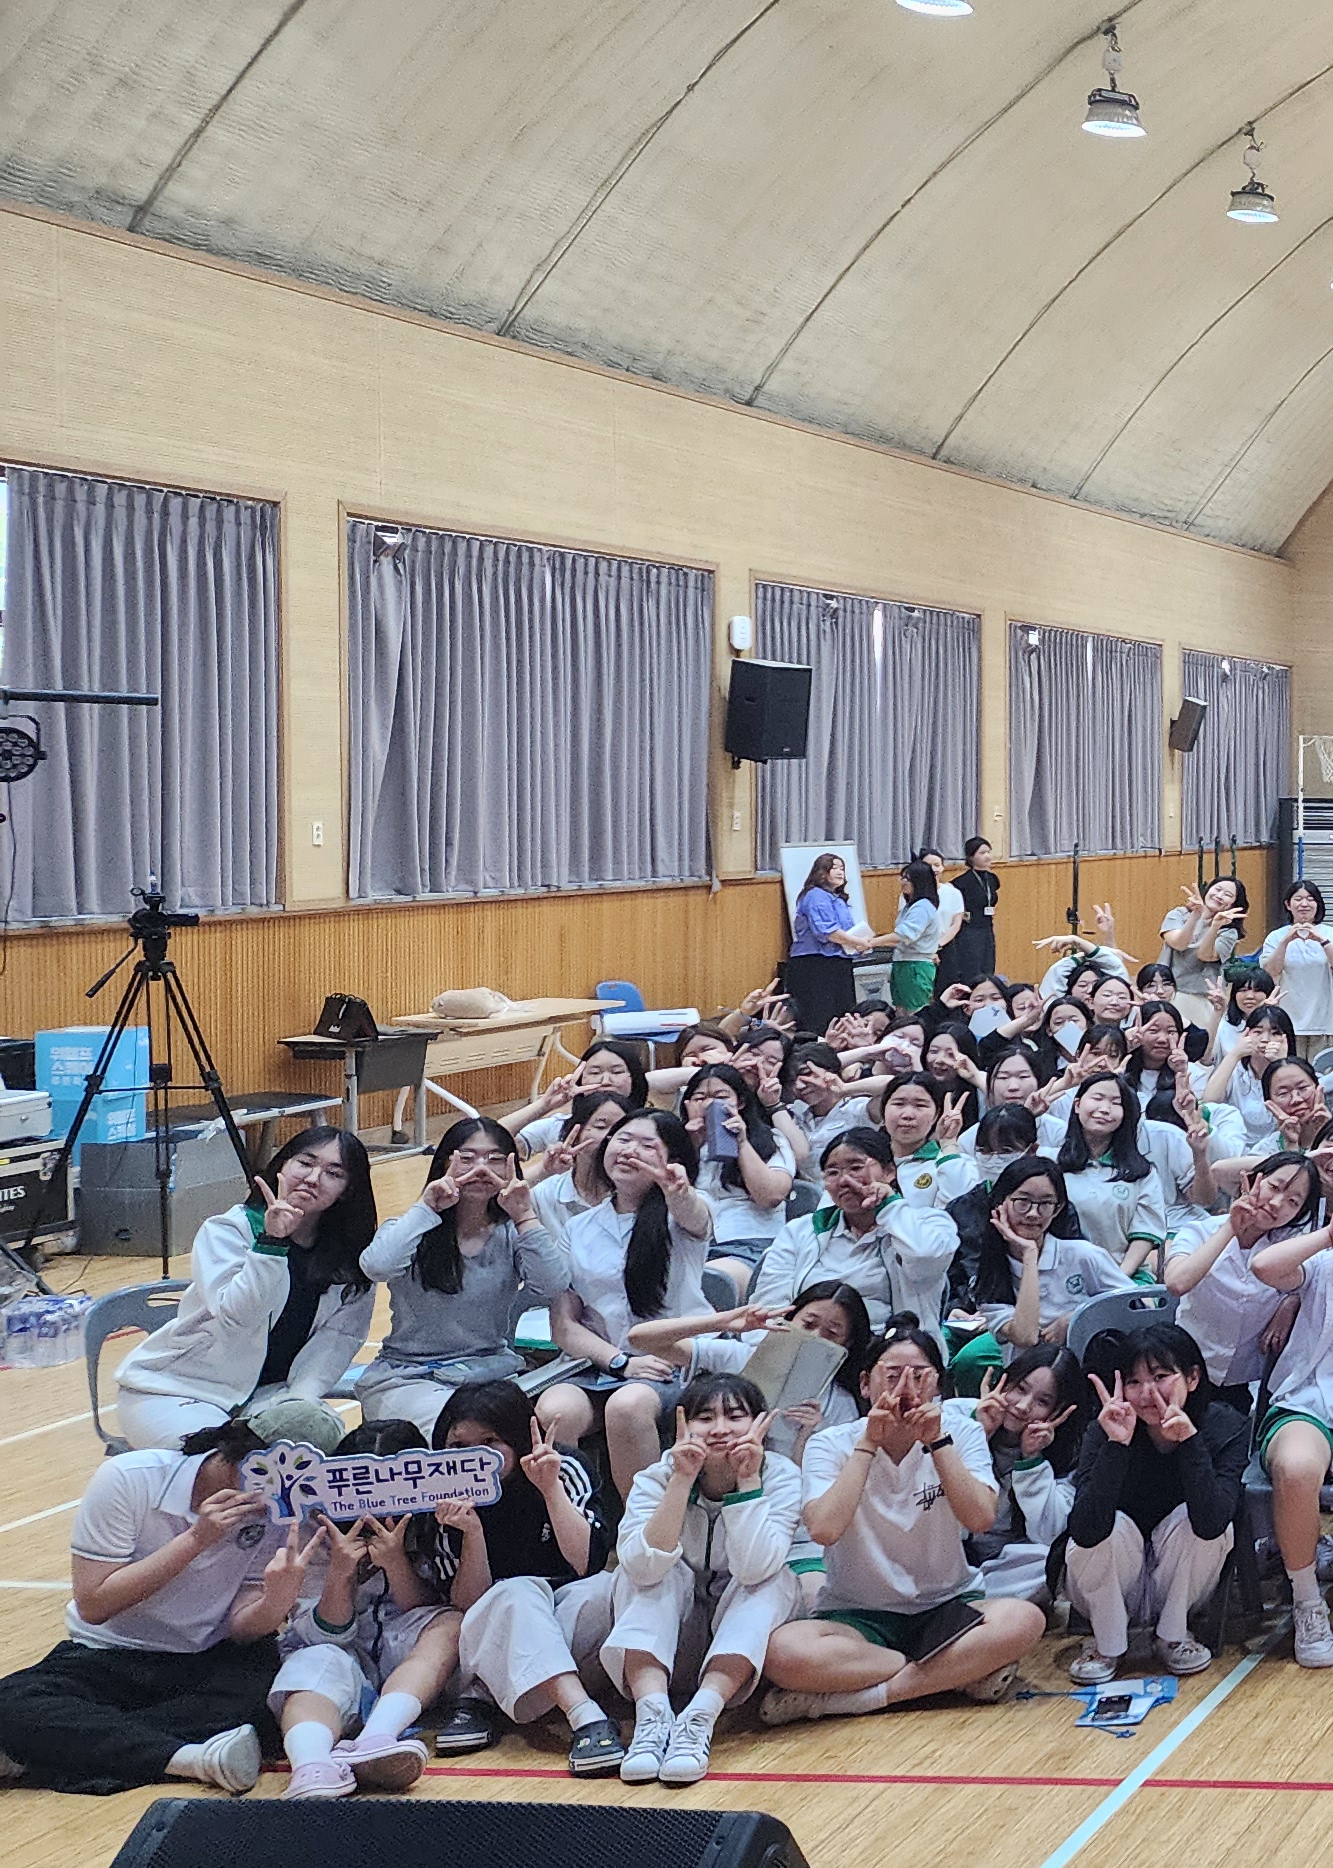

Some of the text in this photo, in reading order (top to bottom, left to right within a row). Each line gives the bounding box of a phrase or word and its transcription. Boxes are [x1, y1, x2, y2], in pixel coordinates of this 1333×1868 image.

[325, 1456, 492, 1498] 푸른나무재단
[331, 1501, 355, 1513] The
[358, 1498, 387, 1509] Blue
[390, 1494, 418, 1507] Tree
